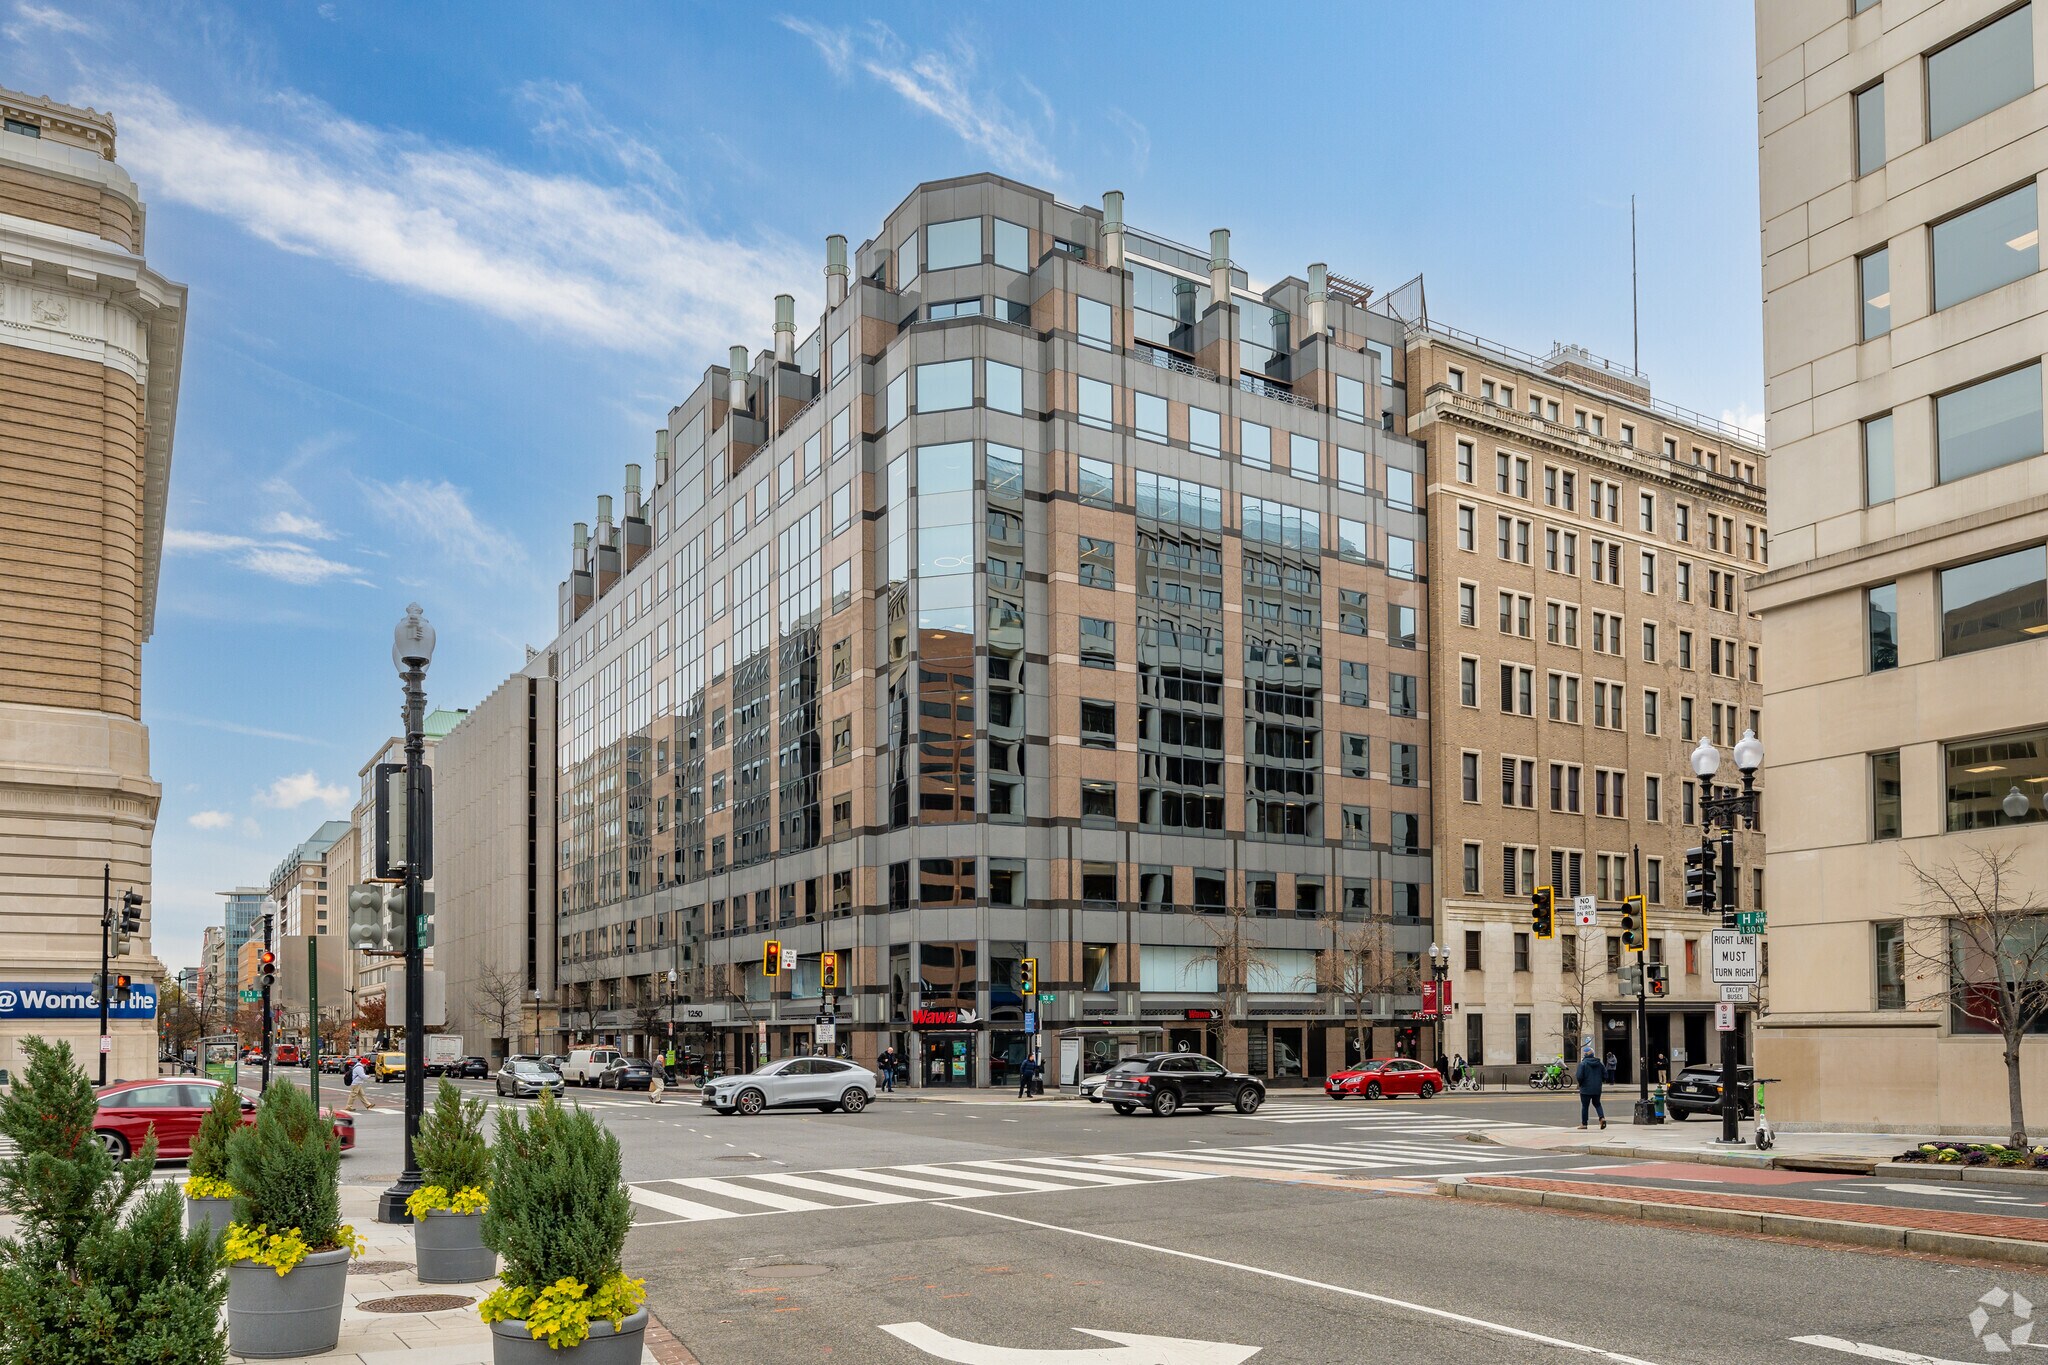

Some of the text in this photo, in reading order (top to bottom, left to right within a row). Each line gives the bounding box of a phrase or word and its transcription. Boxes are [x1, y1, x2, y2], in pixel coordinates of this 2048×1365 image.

[1742, 913, 1750, 924] H
[1714, 936, 1754, 944] RIGHT LANE
[1723, 952, 1746, 961] MUST
[1715, 968, 1754, 976] TURN RIGHT
[129, 992, 154, 1009] the
[913, 1010, 956, 1024] Wawa
[1189, 1010, 1210, 1018] Wawa
